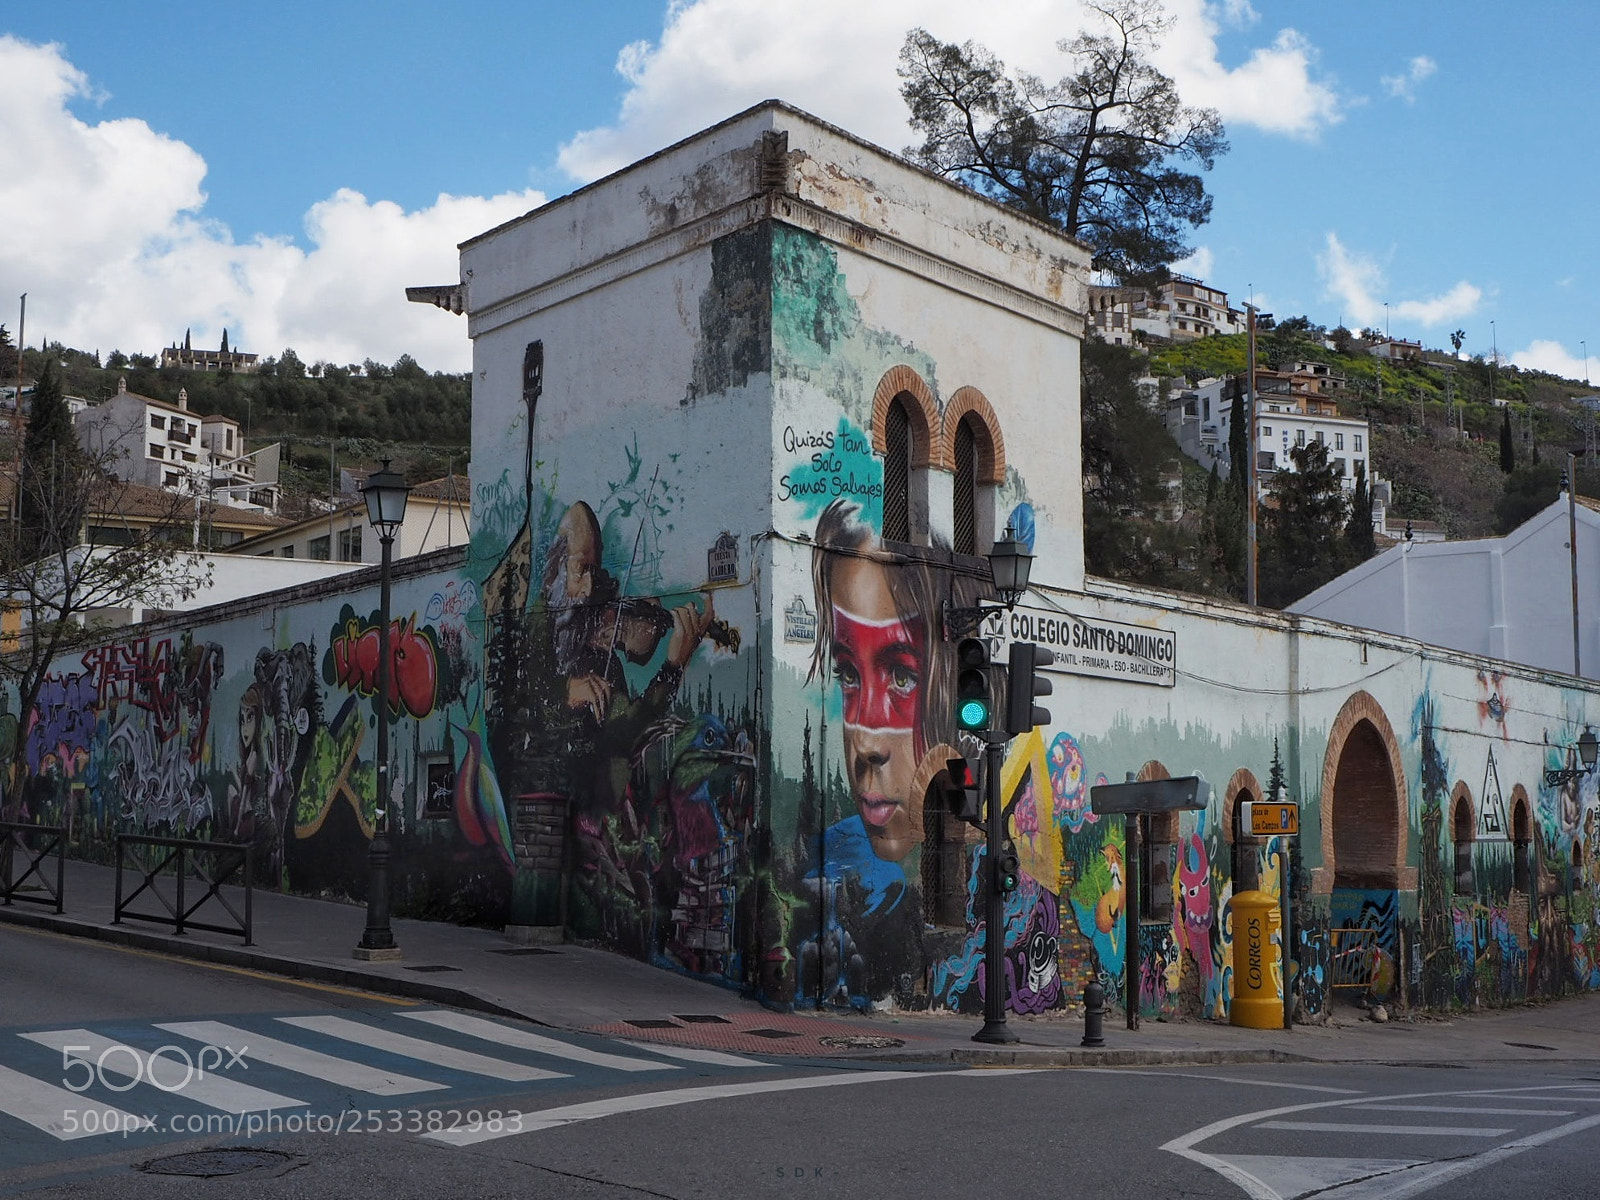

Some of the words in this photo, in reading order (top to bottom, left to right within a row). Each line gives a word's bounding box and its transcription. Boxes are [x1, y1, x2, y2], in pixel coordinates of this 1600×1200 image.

[783, 425, 835, 455] Quizás
[839, 424, 869, 455] tan
[778, 475, 827, 501] Somos
[1011, 613, 1069, 646] COLEGIO
[1073, 623, 1114, 653] SANTO
[1118, 631, 1173, 662] DOMINGO
[1052, 652, 1078, 665] NFANTIL
[1082, 656, 1110, 670] PRIMARIA
[1114, 661, 1126, 672] ESO
[1247, 917, 1262, 990] CORREOS
